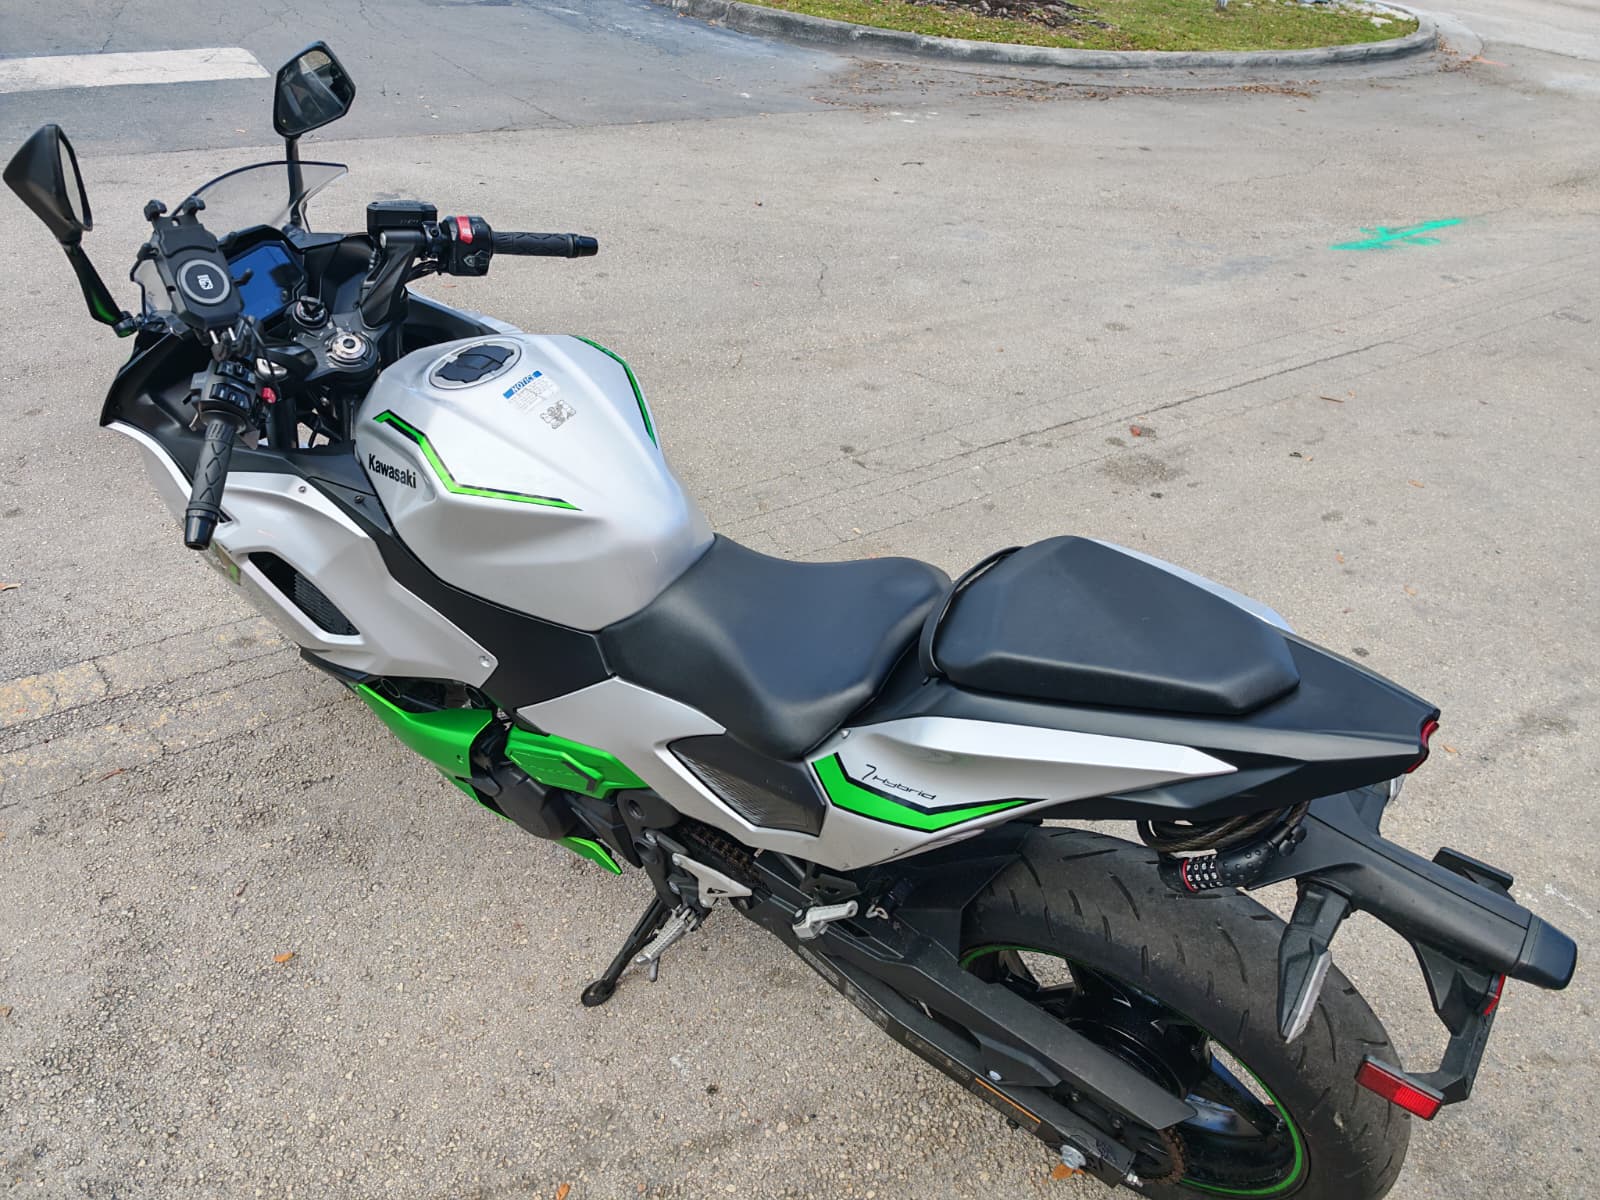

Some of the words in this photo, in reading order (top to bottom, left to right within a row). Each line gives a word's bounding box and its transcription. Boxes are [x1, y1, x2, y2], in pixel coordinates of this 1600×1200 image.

[368, 453, 417, 489] Kawasaki
[861, 763, 877, 780] 7
[872, 775, 937, 800] Hybrid
